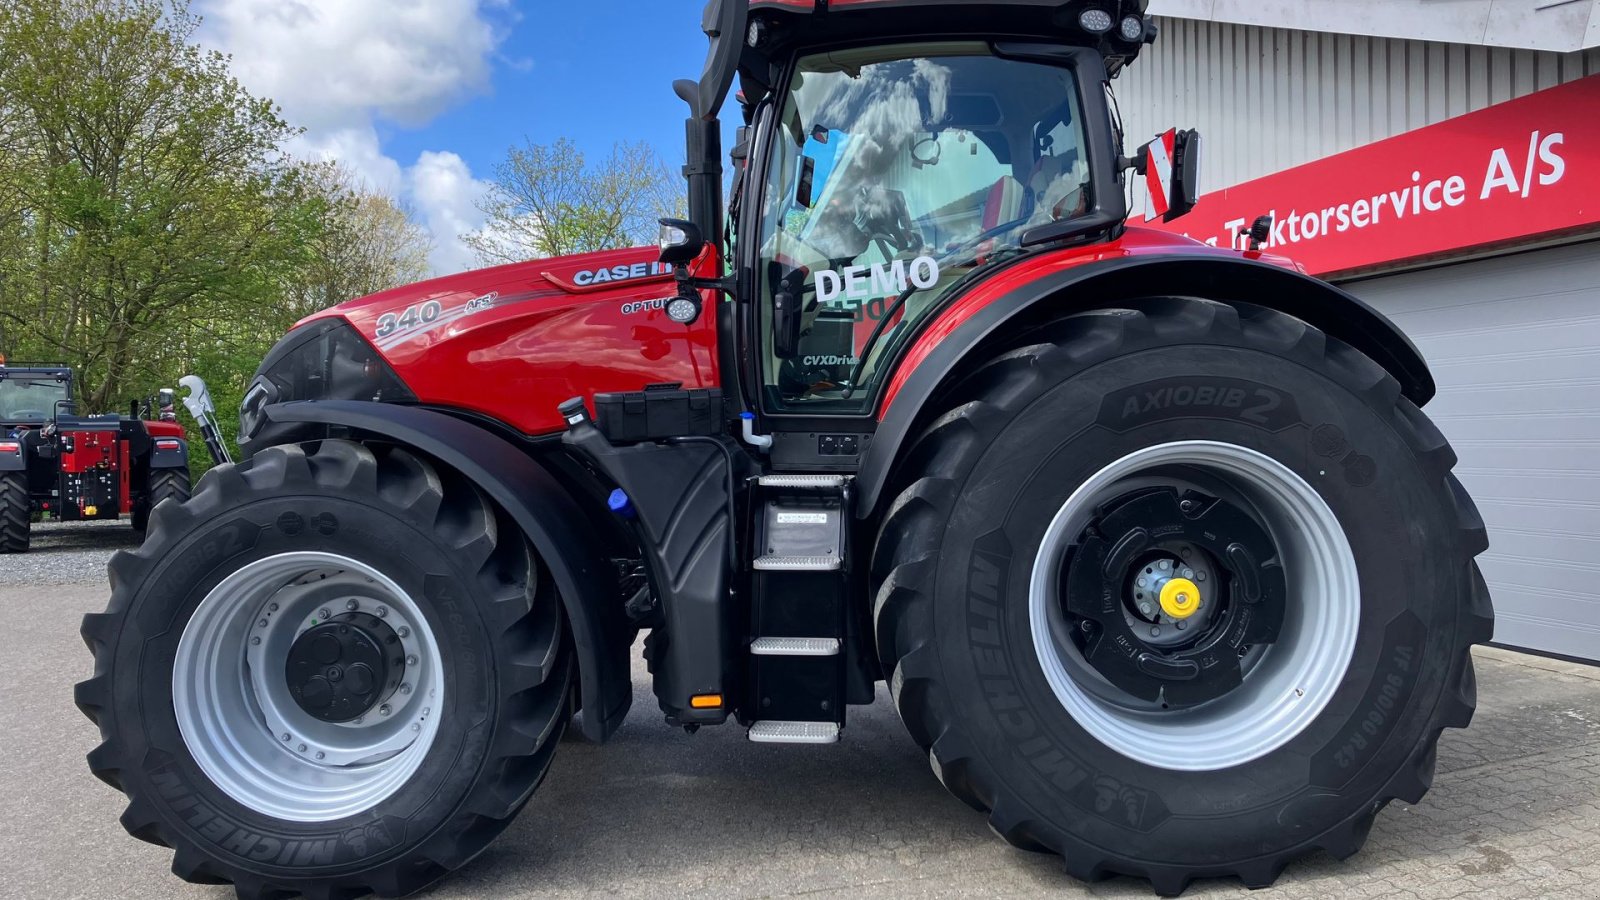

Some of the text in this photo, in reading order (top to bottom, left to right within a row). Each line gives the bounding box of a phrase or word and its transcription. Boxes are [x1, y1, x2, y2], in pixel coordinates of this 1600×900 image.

[1224, 130, 1566, 250] Trktorservice A/S
[573, 262, 647, 286] CASE
[814, 256, 939, 302] DEMO
[375, 300, 442, 339] 340
[803, 355, 861, 366] CVXDrive
[1121, 385, 1281, 424] AXIOBIB 2
[968, 550, 1090, 795] MICHELIN
[150, 766, 339, 866] MICHELIN
